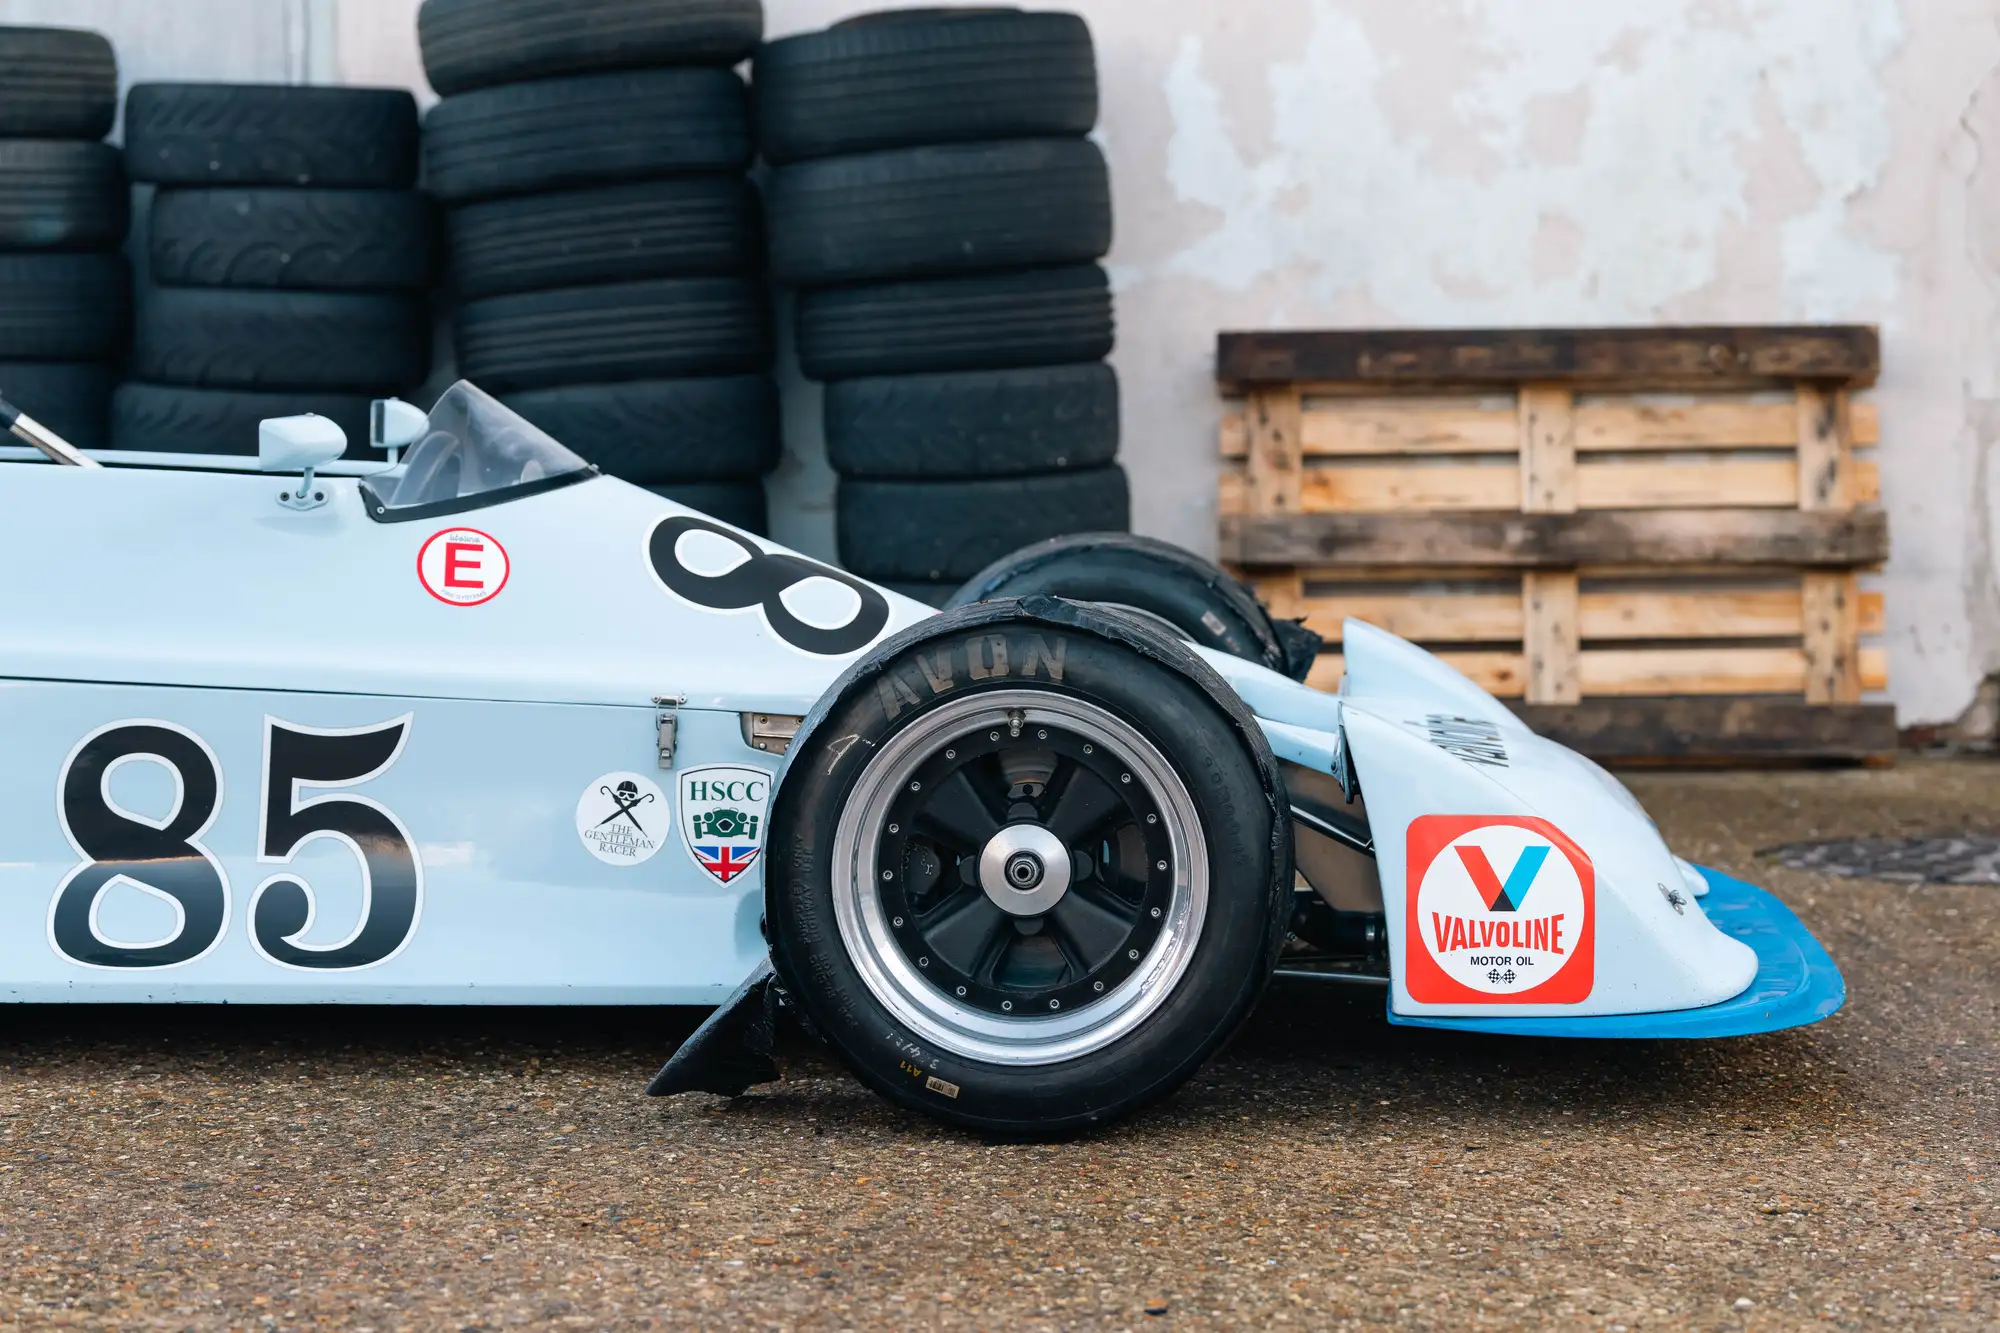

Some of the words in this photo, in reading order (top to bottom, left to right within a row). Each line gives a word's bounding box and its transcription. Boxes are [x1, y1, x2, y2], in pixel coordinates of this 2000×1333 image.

[444, 542, 484, 589] E
[644, 511, 893, 659] 8
[877, 633, 1067, 722] AVON
[689, 781, 764, 802] HSCC
[46, 711, 424, 972] 85
[584, 829, 655, 849] GENTLEMAN
[610, 823, 633, 836] THE
[599, 843, 637, 858] RACER
[1432, 911, 1564, 955] VALVOLINE
[1470, 956, 1512, 966] MOTOR
[1516, 956, 1534, 966] OIL
